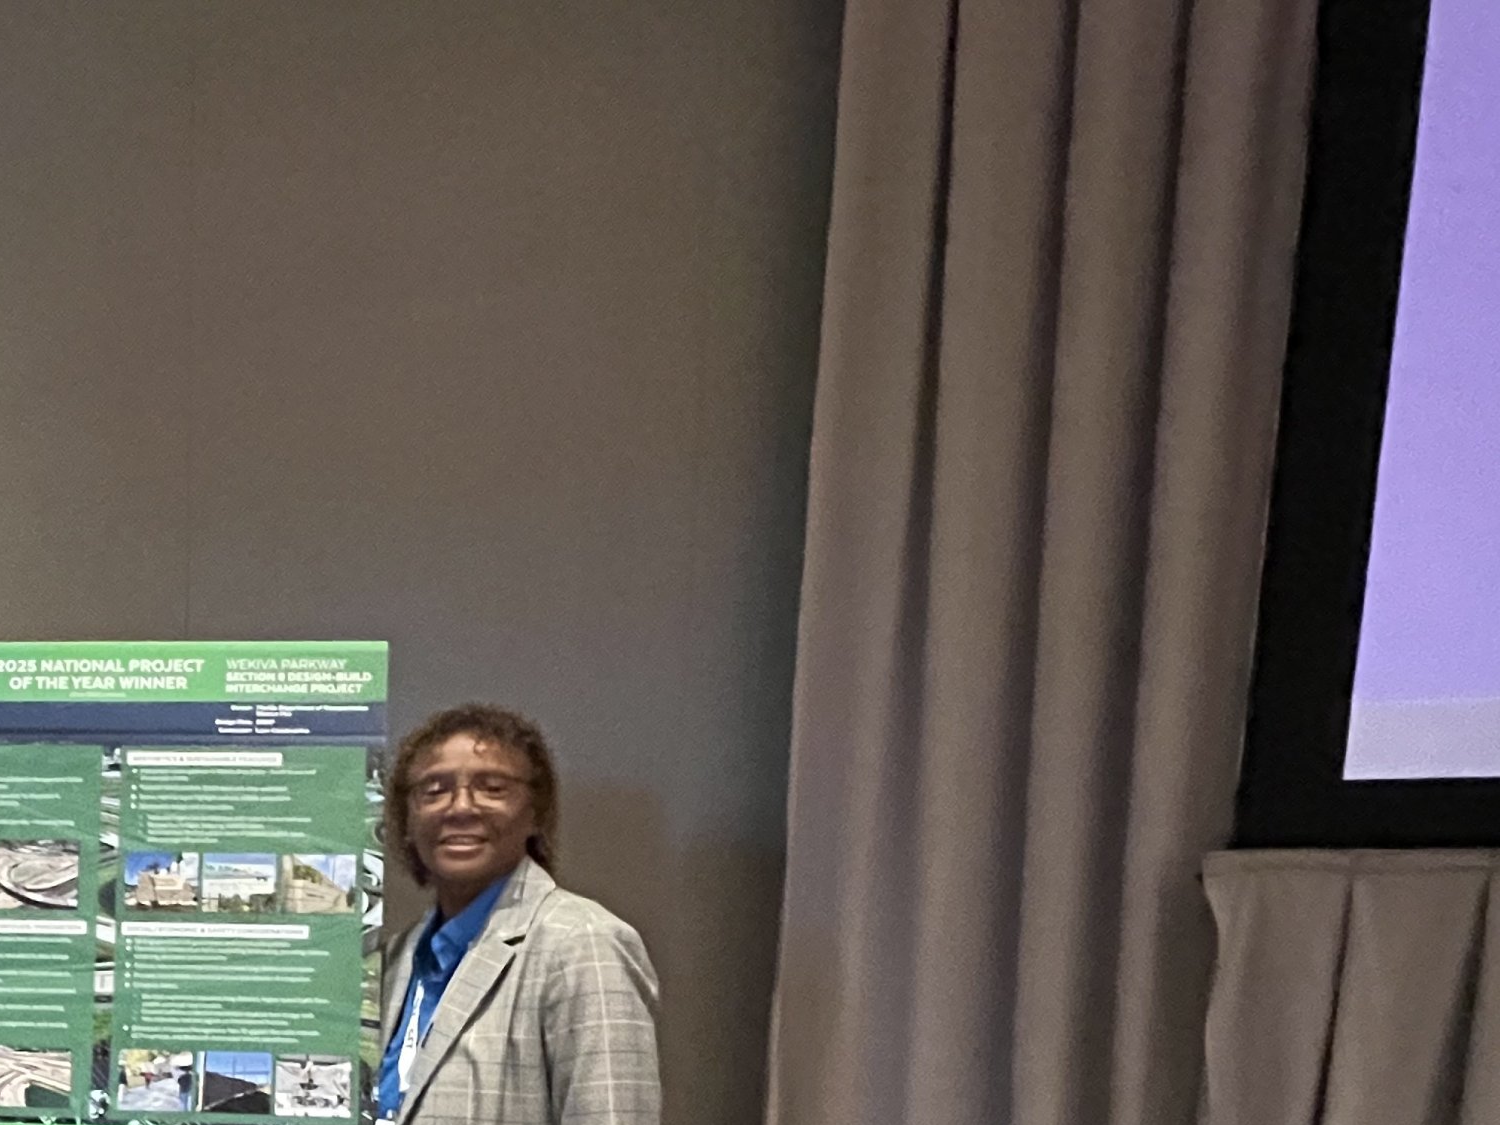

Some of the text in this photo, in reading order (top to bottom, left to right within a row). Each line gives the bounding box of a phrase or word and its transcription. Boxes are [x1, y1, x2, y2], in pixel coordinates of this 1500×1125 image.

[41, 659, 125, 673] NATIONAL
[129, 659, 205, 673] PROJECT
[226, 658, 347, 671] WEKIVA PARKWAY
[8, 676, 188, 690] OF THE YEAR WINNER
[225, 671, 276, 682] SECTION
[225, 683, 363, 694] INTERCHANGE PROJECT
